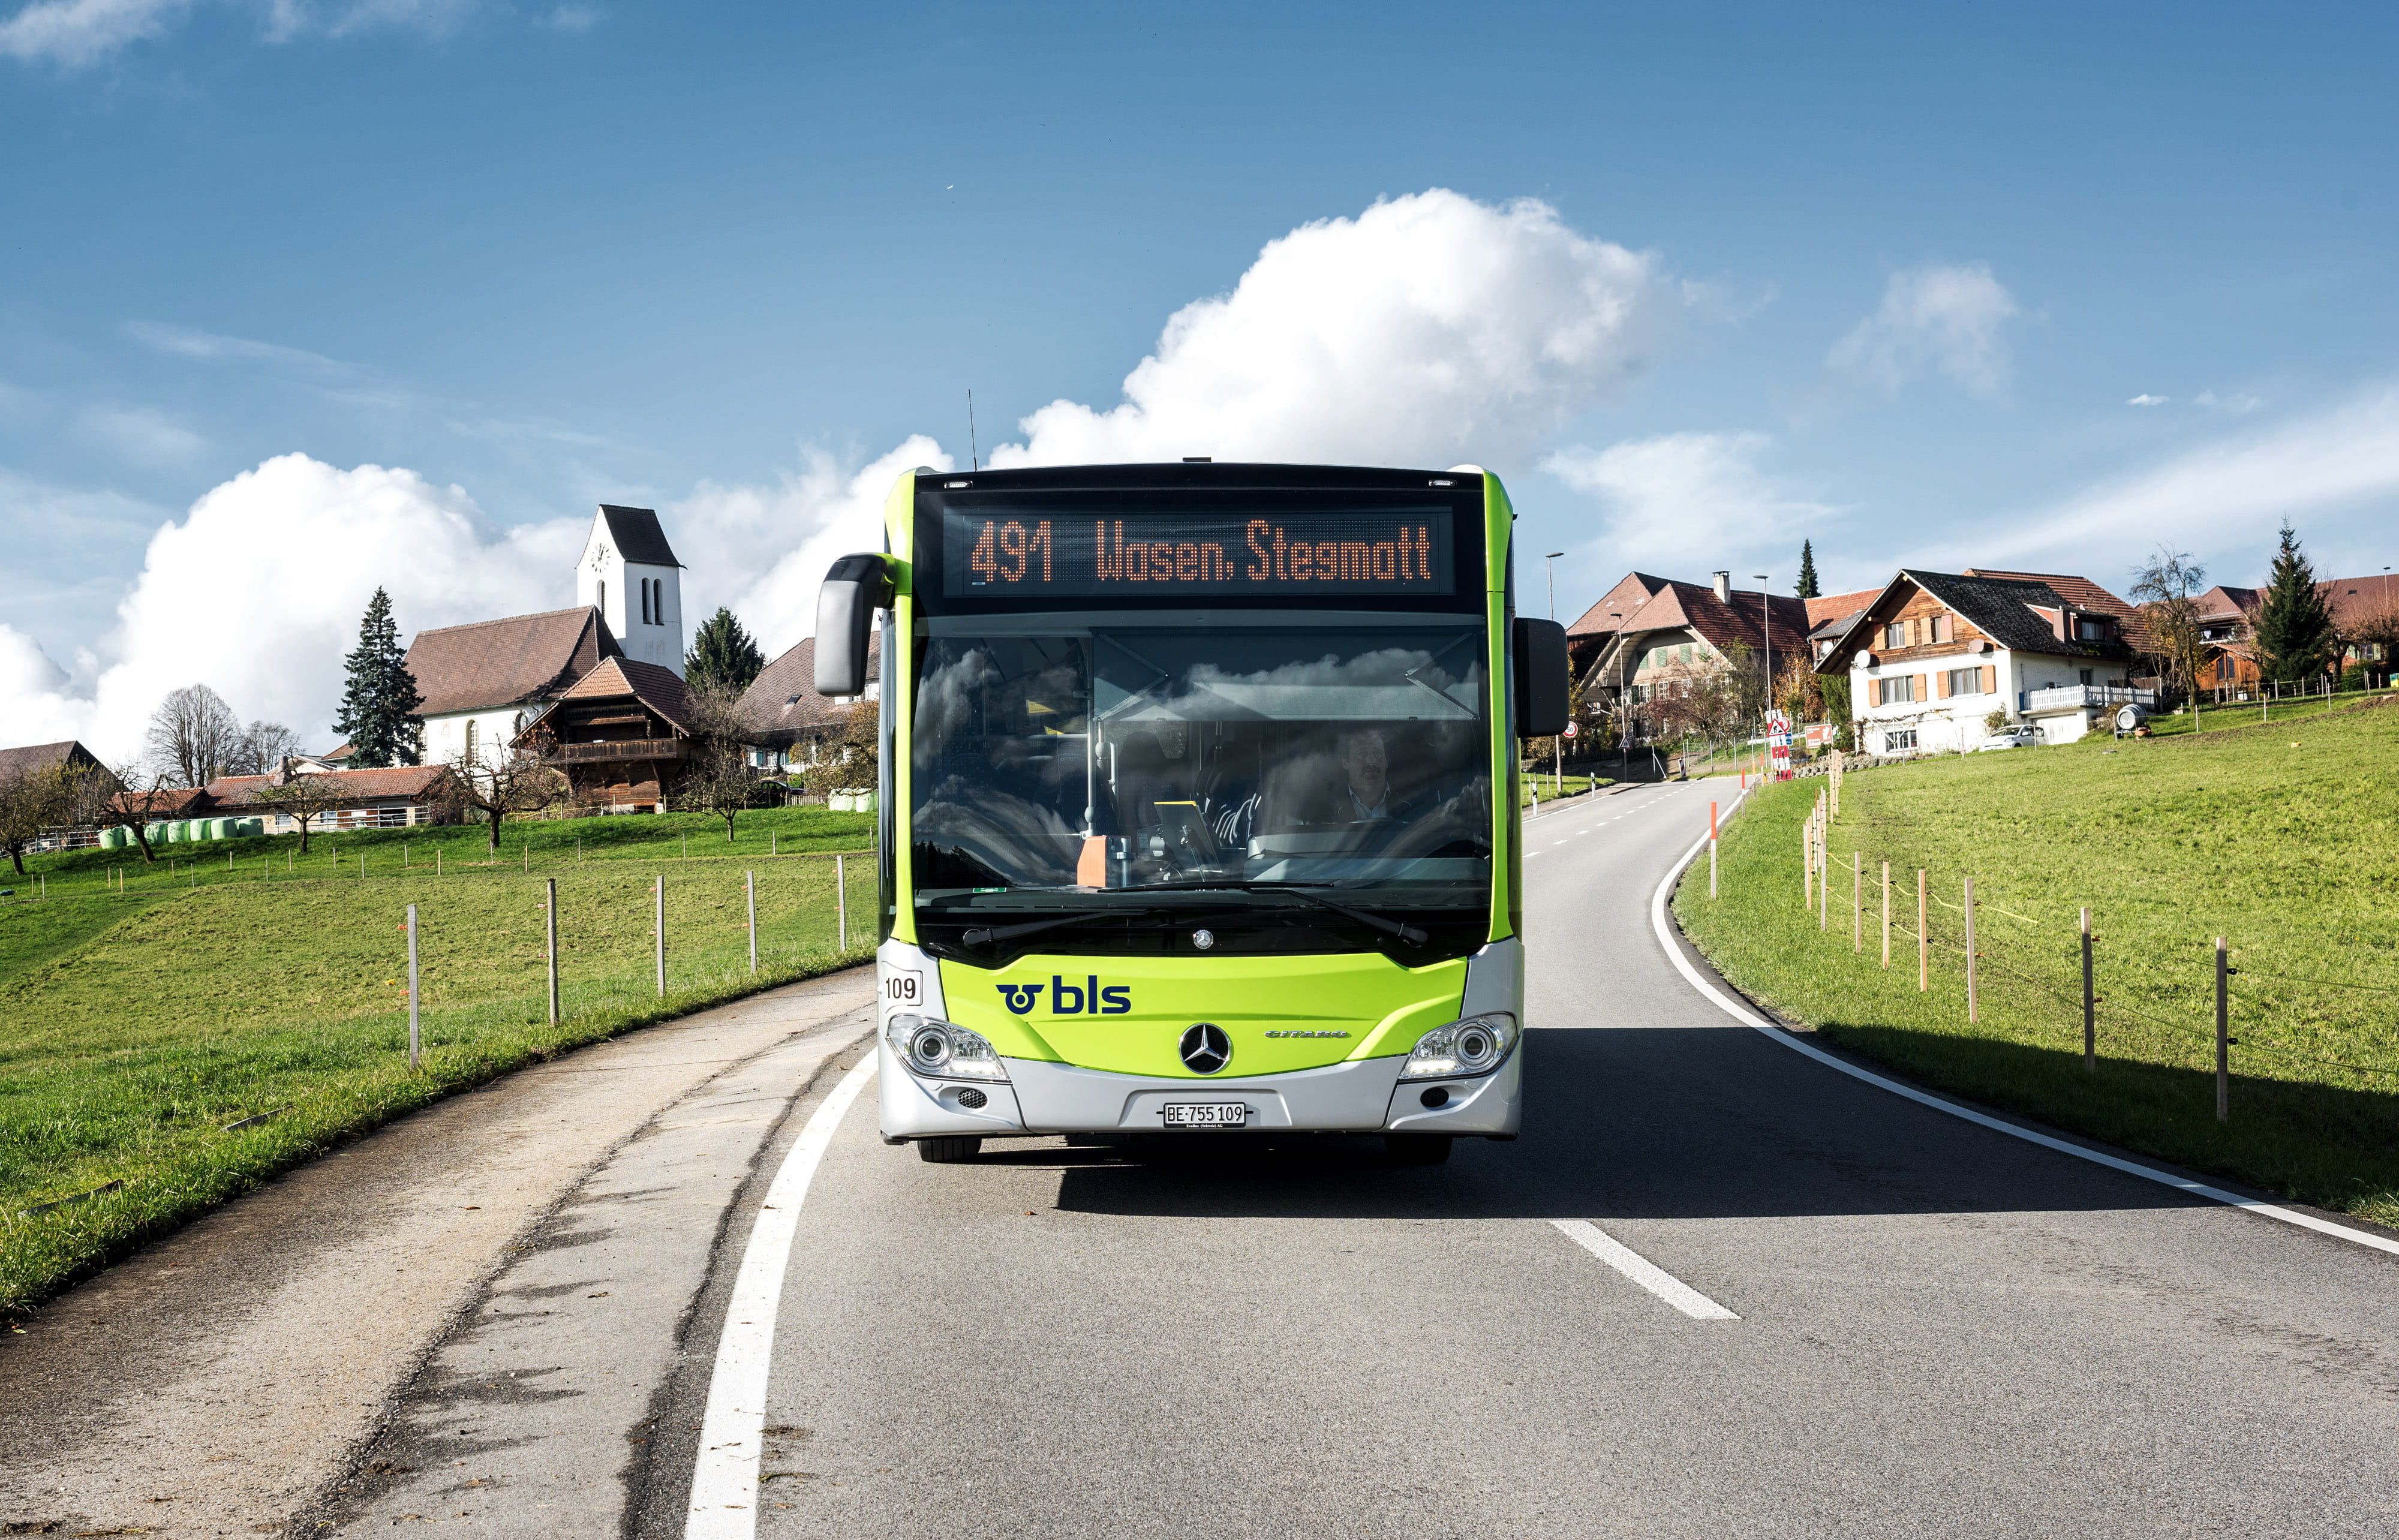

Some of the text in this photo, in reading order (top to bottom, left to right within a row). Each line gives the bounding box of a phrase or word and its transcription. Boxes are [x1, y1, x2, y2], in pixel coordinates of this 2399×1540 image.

[972, 519, 1431, 582] 491 Wasen, Stegmatt
[886, 977, 916, 999] 109
[1052, 975, 1131, 1014] bls
